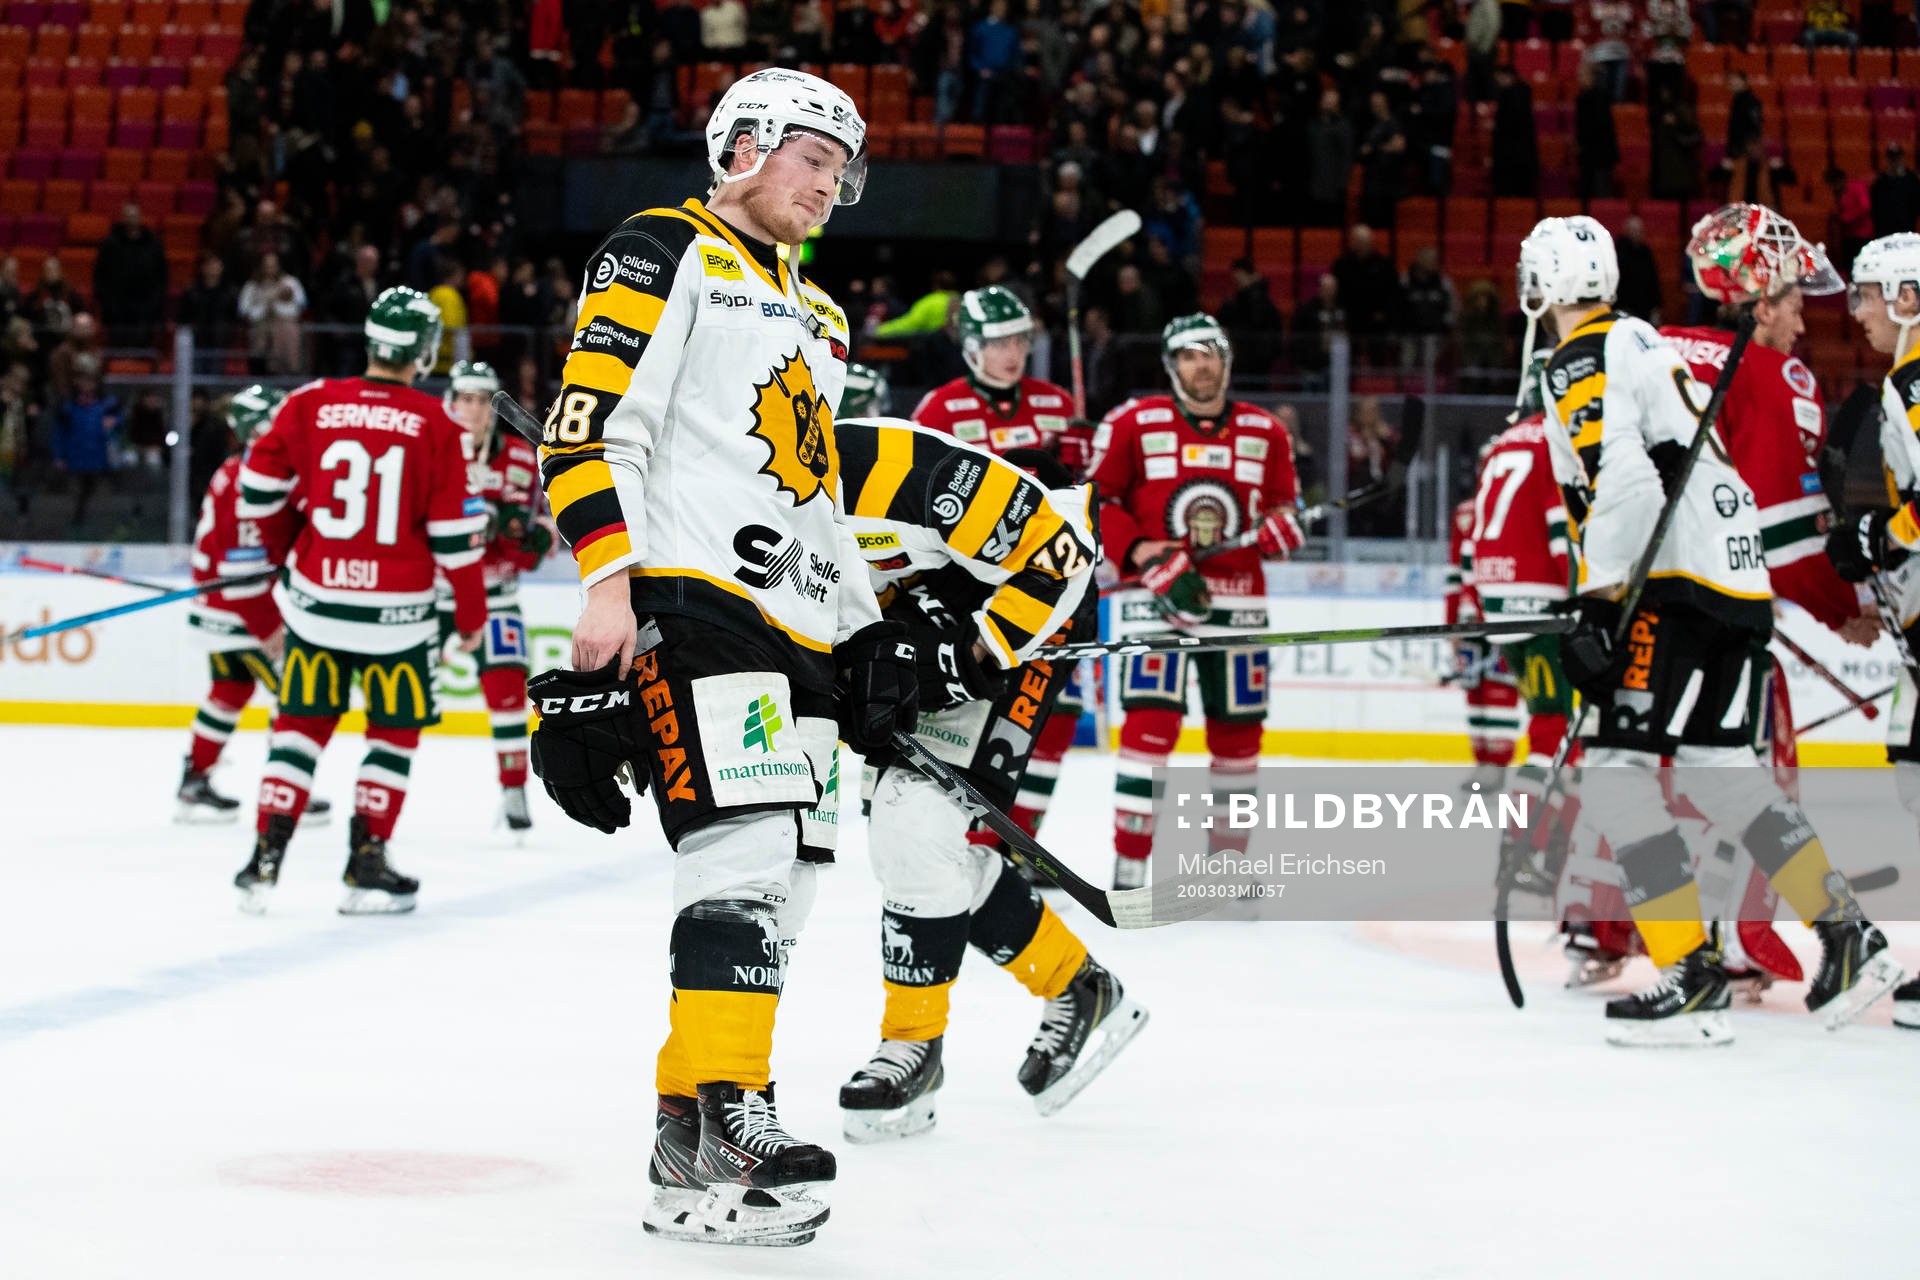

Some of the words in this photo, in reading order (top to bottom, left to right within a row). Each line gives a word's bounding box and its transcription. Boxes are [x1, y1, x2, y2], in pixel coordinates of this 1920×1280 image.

[736, 102, 769, 110] CCM
[617, 265, 653, 286] lectro
[621, 254, 661, 274] oliden
[586, 333, 613, 346] Kraft
[589, 322, 641, 348] Skellefteå
[316, 403, 424, 437] SERNEKE
[948, 459, 972, 492] Boliden
[957, 465, 982, 498] Electro
[311, 440, 405, 546] 31
[321, 557, 378, 589] LASU
[541, 688, 630, 715] CCM
[631, 649, 697, 803] REPAY
[718, 763, 810, 782] martinsons
[886, 899, 916, 913] CCM
[884, 962, 936, 984] RRAN
[719, 1145, 748, 1169] CCM
